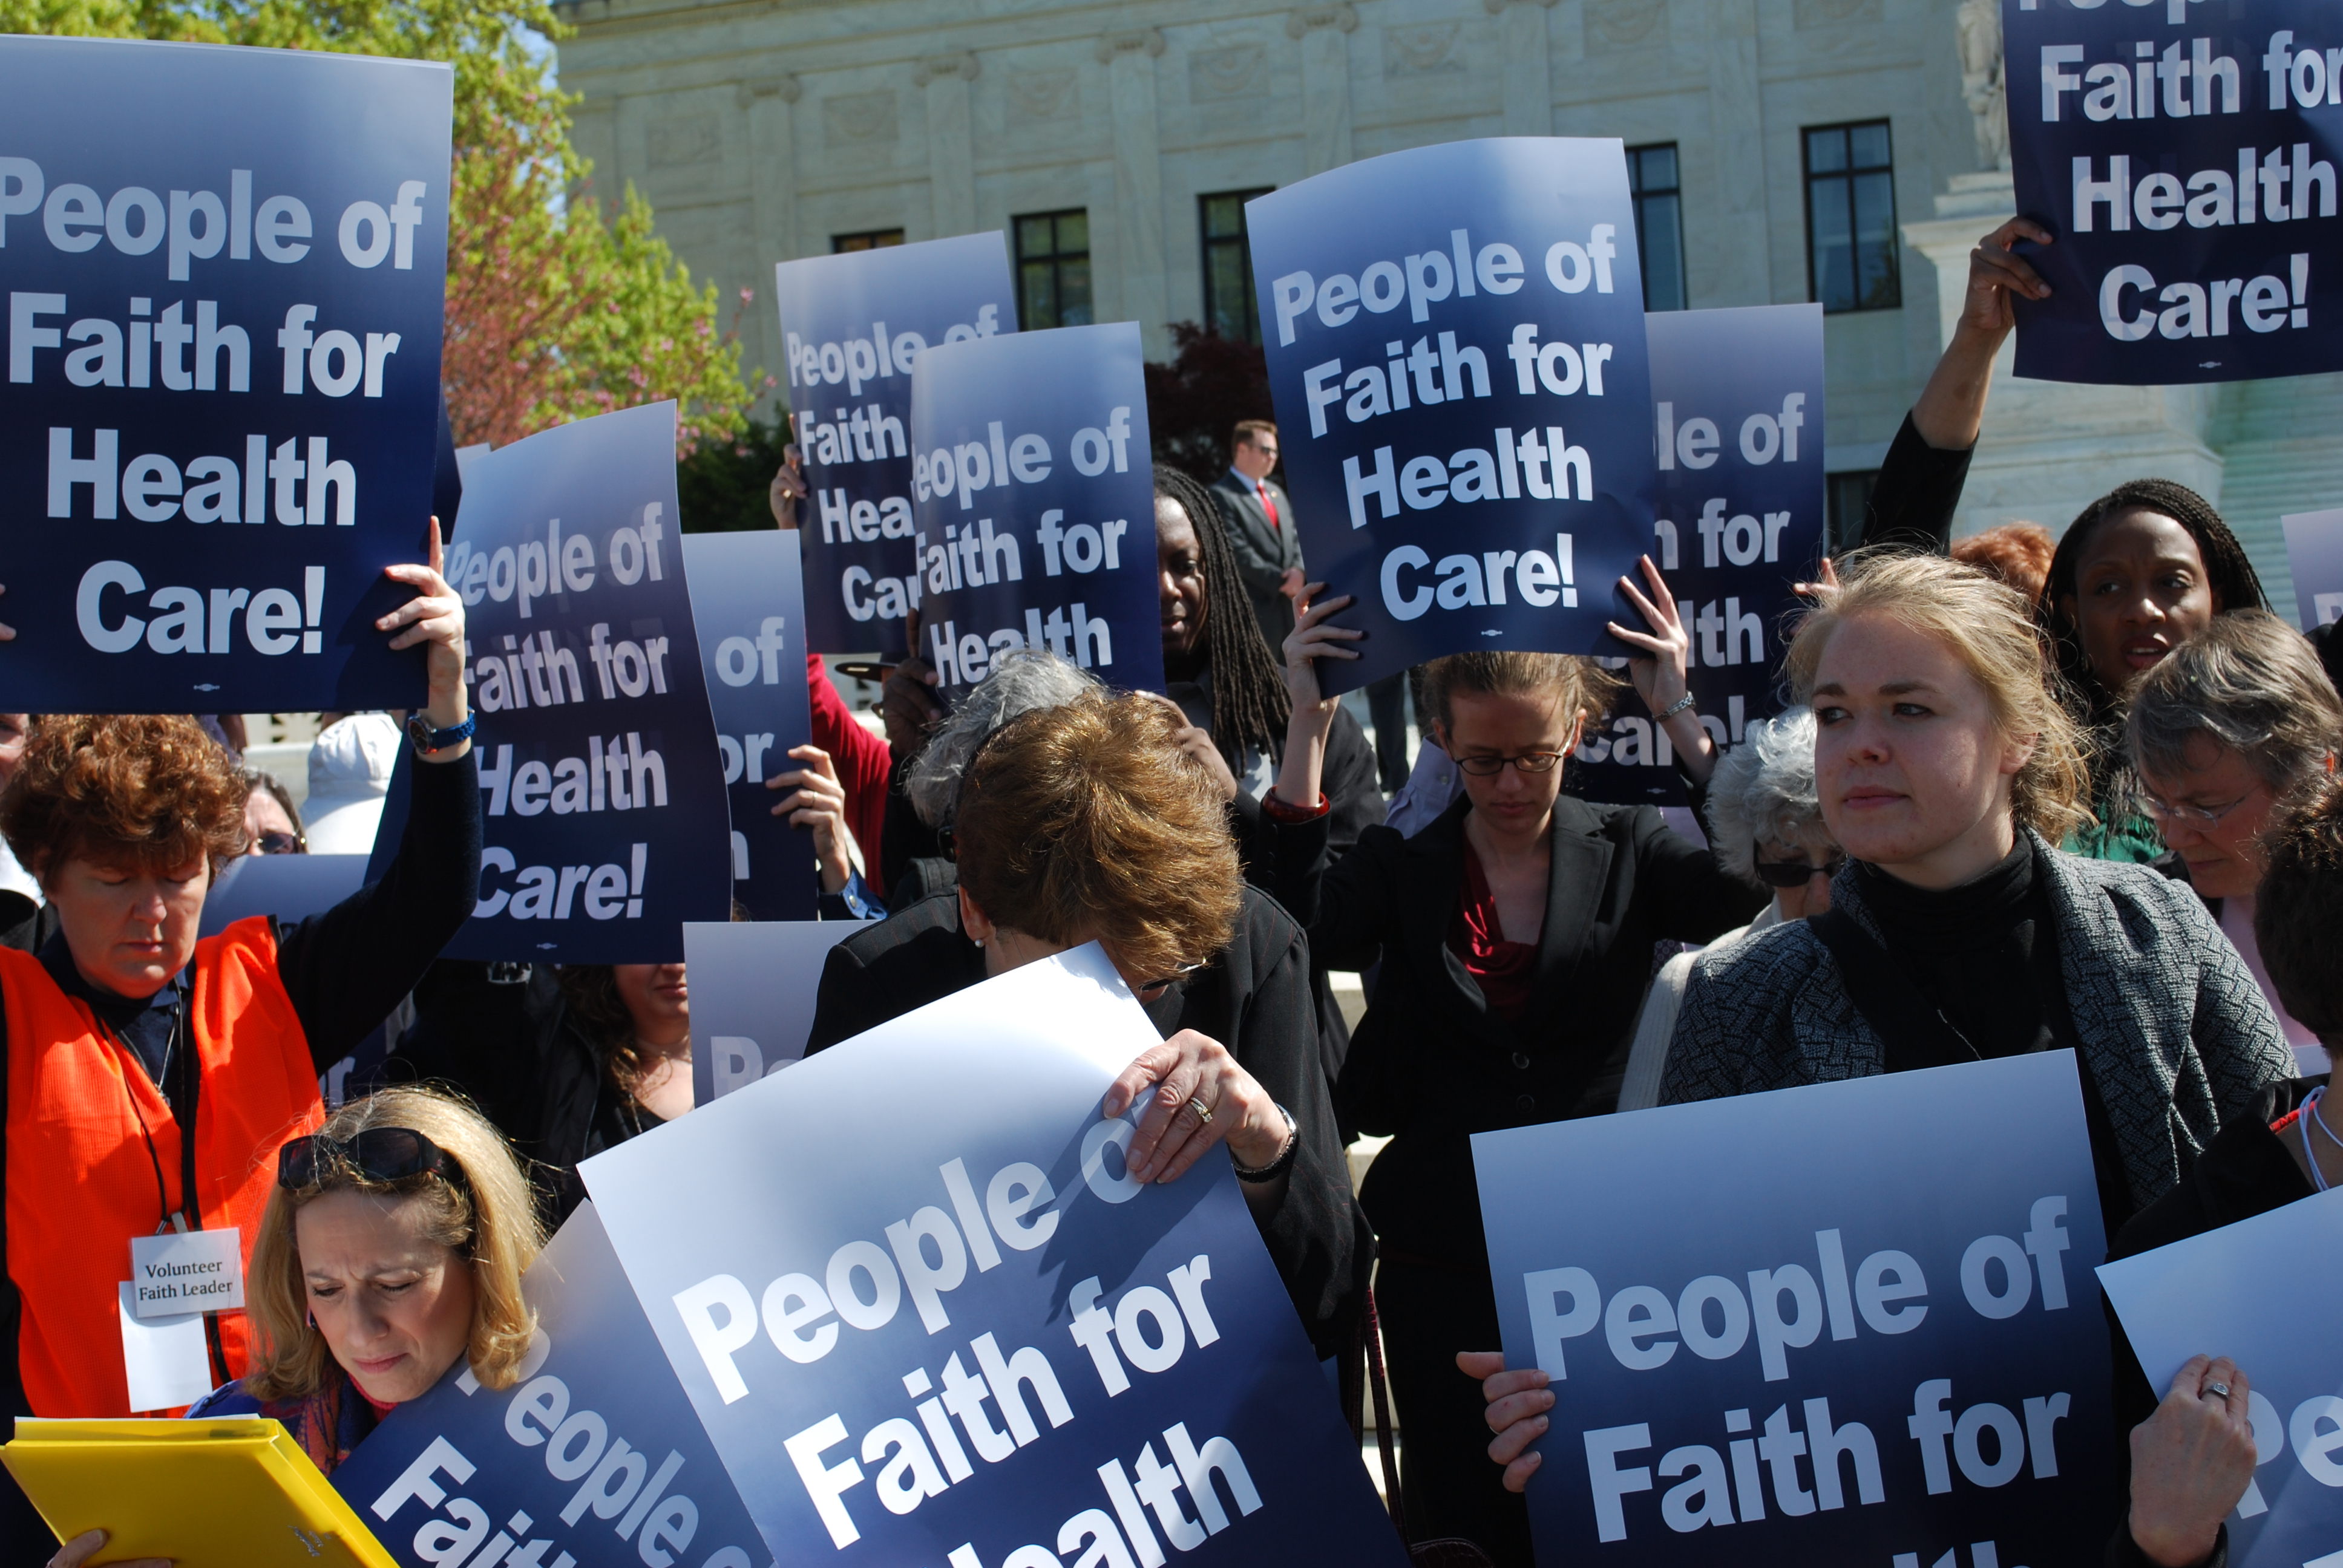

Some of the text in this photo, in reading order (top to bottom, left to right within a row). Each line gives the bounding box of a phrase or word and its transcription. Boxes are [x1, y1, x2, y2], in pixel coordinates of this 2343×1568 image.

[2041, 38, 2240, 122] Faith
[0, 156, 427, 281] People of
[2073, 143, 2337, 232] Health
[1273, 224, 1616, 347] People of
[2099, 253, 2309, 341] Care!
[8, 292, 401, 397] Faith for
[788, 322, 927, 396] People
[1303, 324, 1613, 439] Faith for
[799, 404, 906, 466] Faith
[910, 407, 1130, 510] eople of
[1739, 393, 1804, 465] of
[47, 427, 356, 526] Health
[1342, 426, 1593, 530] Health
[610, 501, 663, 586] of
[916, 509, 1127, 598] Faith for
[1698, 498, 1791, 567] for
[76, 560, 325, 655] Care!
[1380, 533, 1578, 621] Care!
[591, 623, 669, 701] for
[715, 616, 785, 687] of
[474, 732, 667, 817] Health
[471, 843, 647, 920] Care!
[139, 1279, 233, 1300] Faith Leader
[146, 1261, 222, 1278] Volunteer
[672, 1157, 1060, 1405] People
[1523, 1195, 2069, 1382] People of
[784, 1254, 1220, 1550] Faith for
[1582, 1378, 2071, 1543] Faith for
